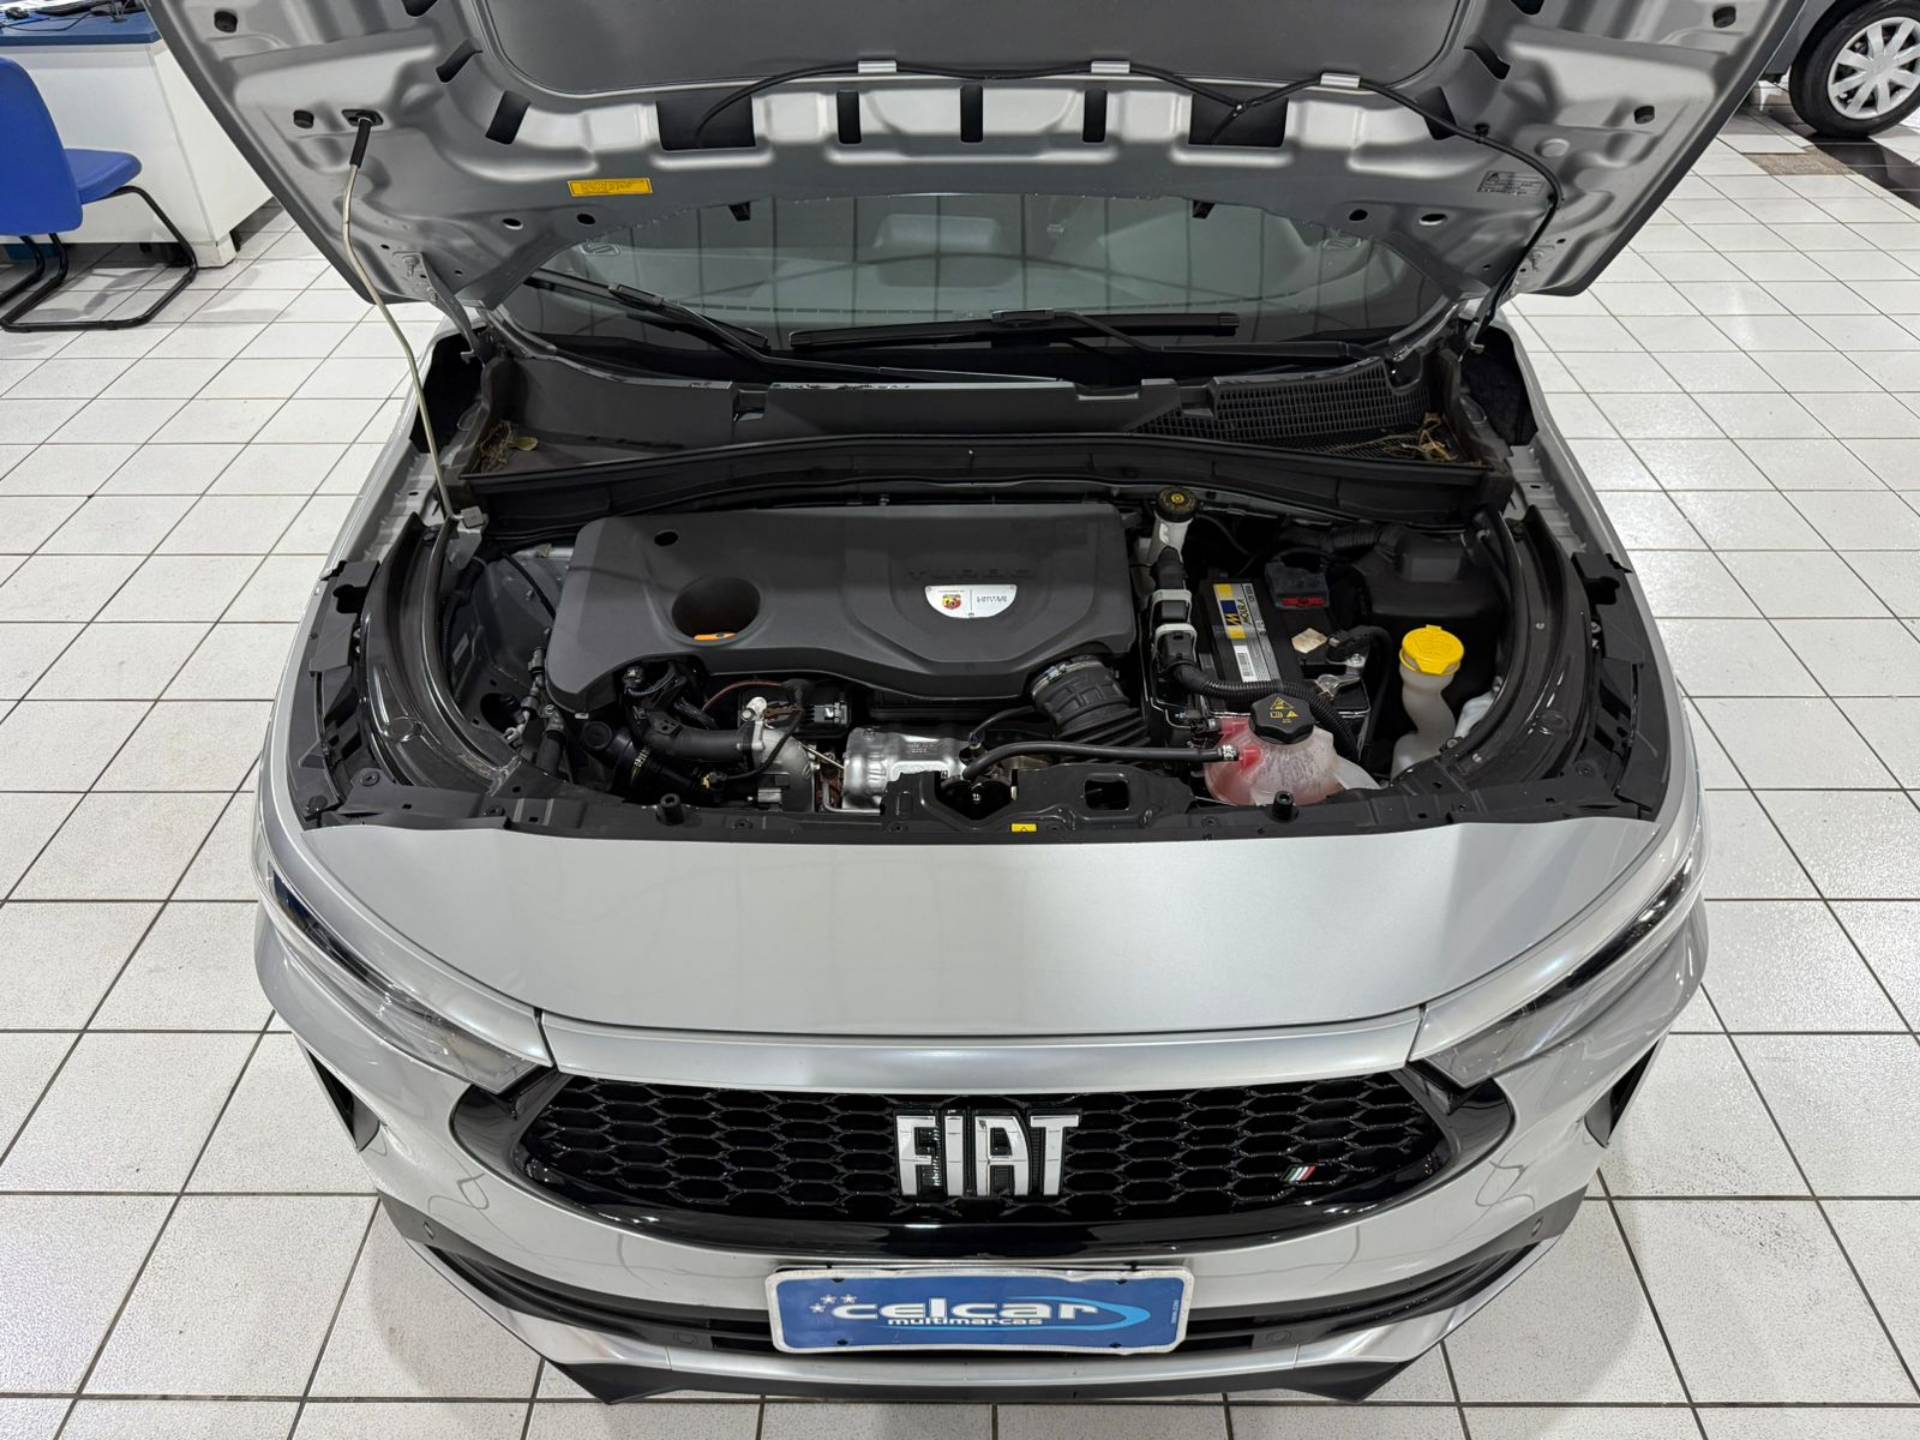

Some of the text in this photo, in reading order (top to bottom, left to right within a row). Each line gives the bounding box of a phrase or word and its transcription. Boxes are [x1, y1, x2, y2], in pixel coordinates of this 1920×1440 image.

[896, 1115, 1080, 1197] FIAT
[831, 1298, 1099, 1320] celcar
[887, 1316, 1043, 1326] multimarcas
